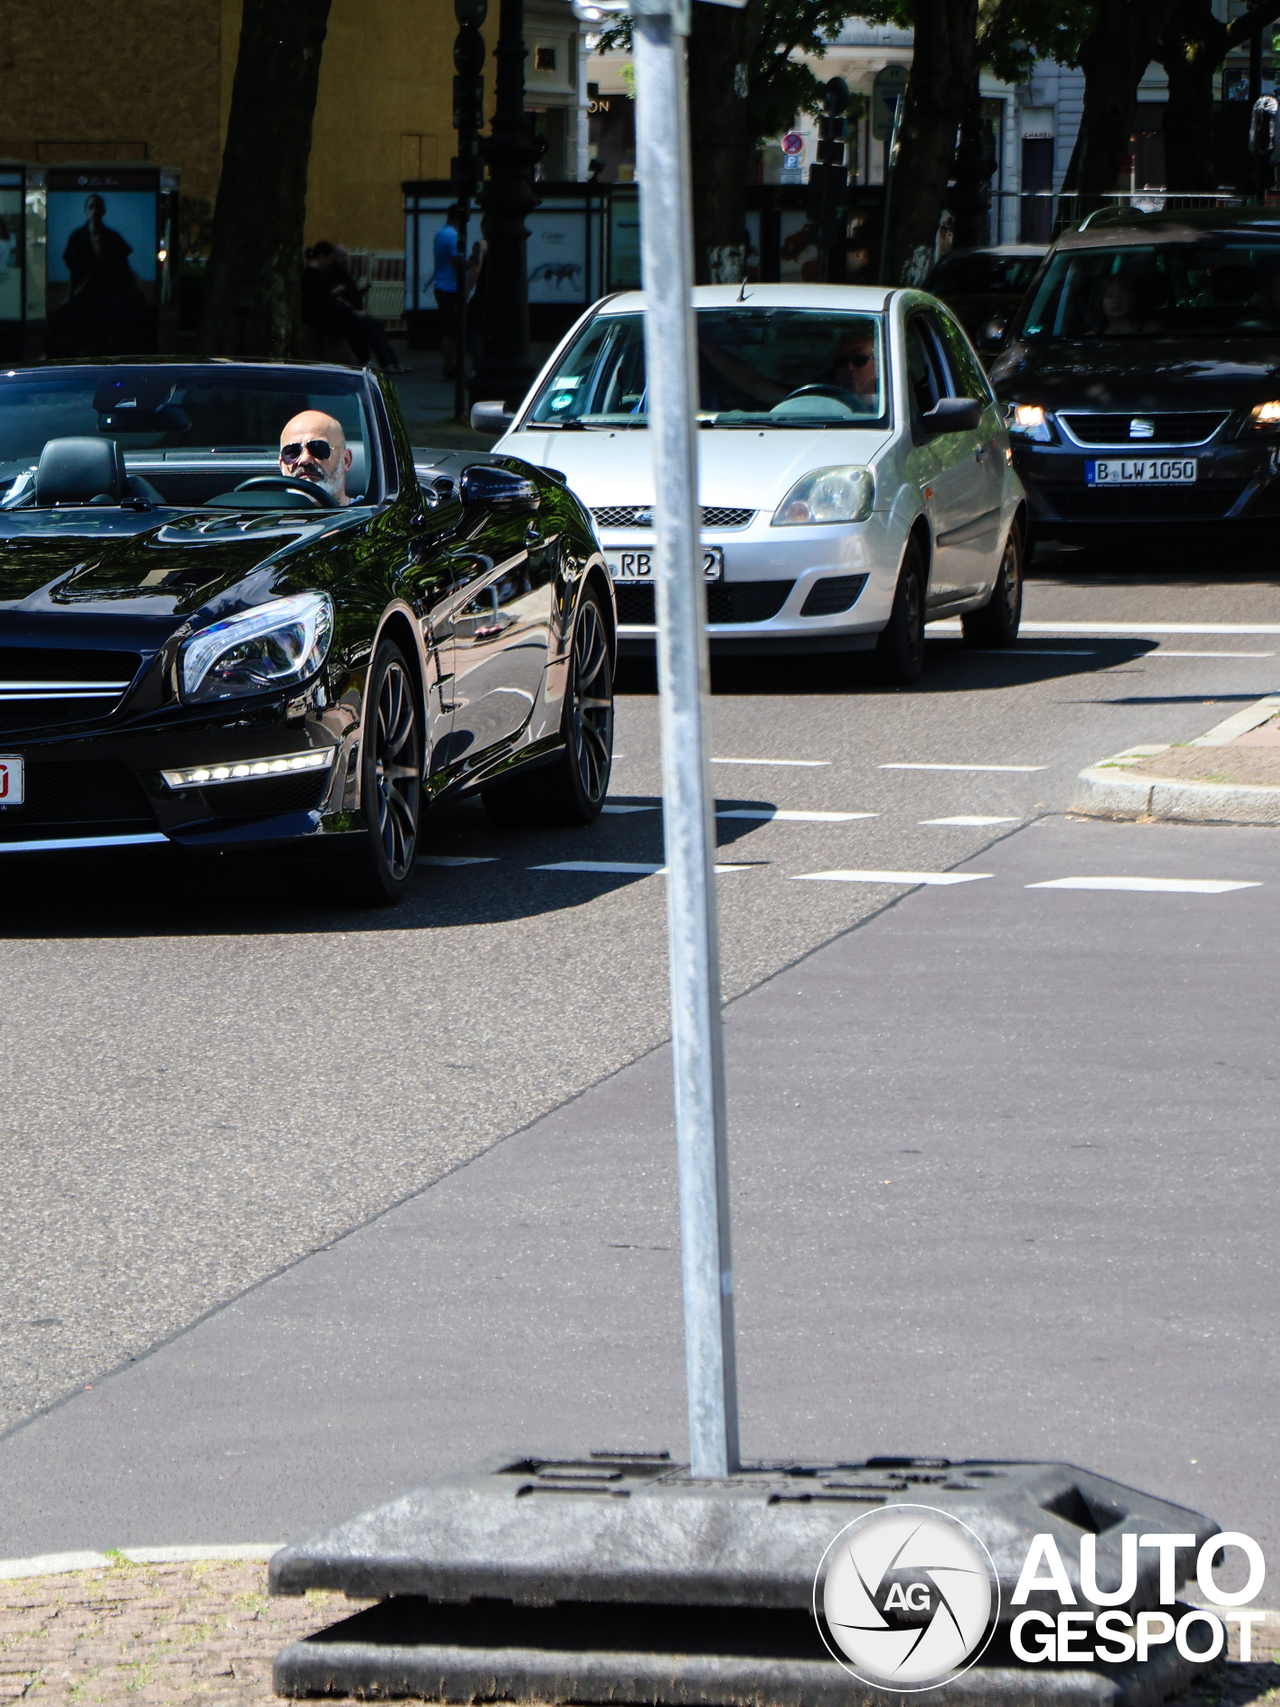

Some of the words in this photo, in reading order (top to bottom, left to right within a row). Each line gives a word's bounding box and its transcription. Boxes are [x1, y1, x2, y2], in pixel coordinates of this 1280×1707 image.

[1097, 463, 1108, 480] B
[1121, 463, 1144, 479] LW
[1149, 462, 1194, 480] 1050
[621, 553, 651, 577] RB
